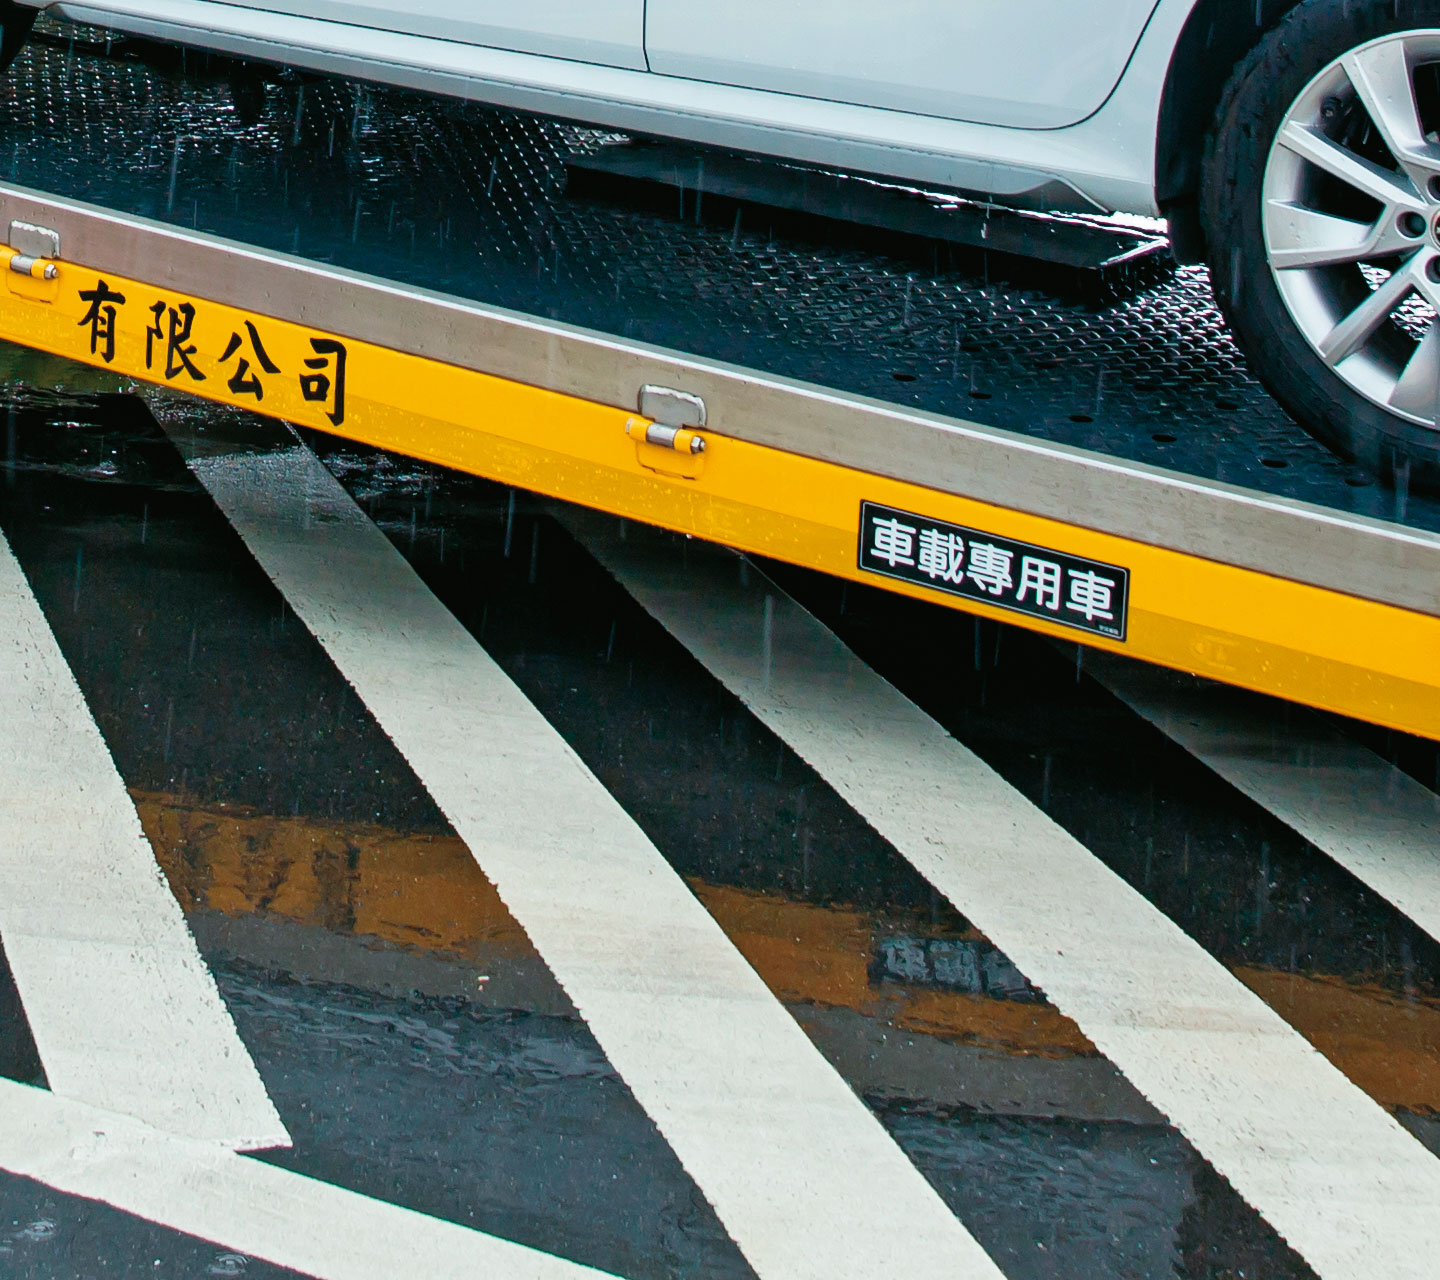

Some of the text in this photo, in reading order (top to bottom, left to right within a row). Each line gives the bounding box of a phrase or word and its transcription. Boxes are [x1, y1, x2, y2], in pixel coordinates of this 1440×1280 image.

[77, 278, 347, 428] 有限公司
[870, 516, 1116, 622] 車載專用車
